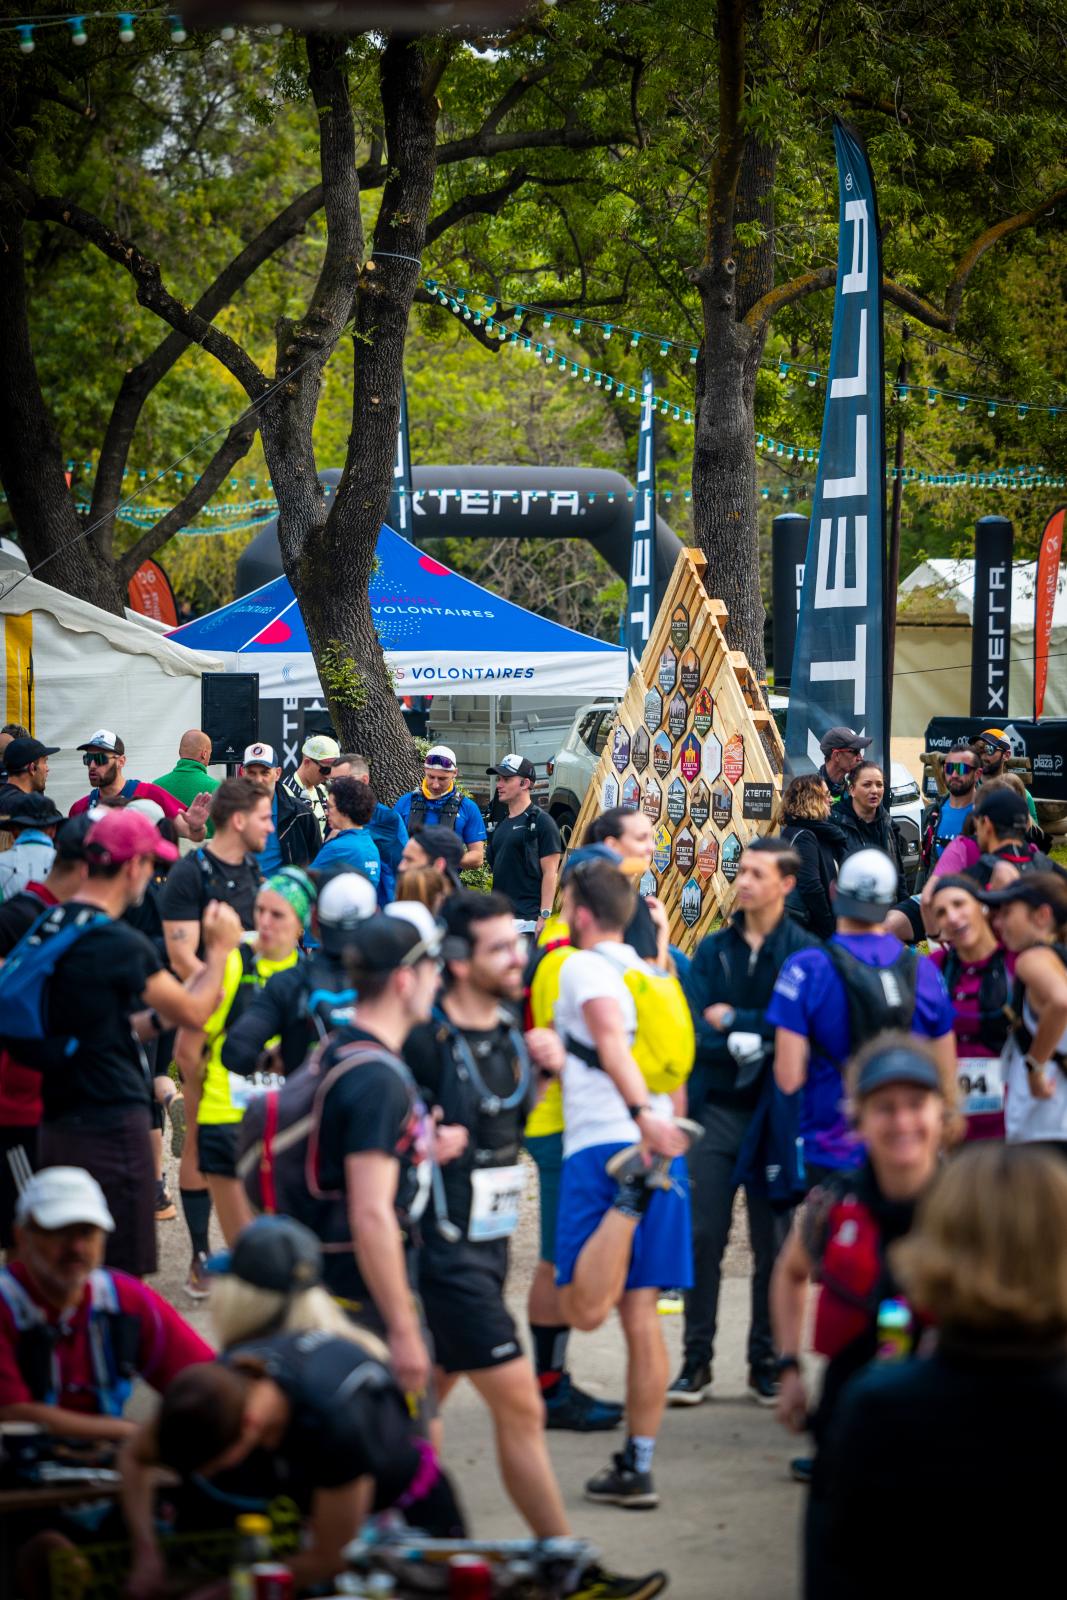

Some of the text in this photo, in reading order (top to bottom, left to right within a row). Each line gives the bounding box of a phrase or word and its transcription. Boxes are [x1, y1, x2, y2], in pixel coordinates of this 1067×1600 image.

[372, 606, 495, 618] VOLONTAIRES
[988, 565, 1006, 709] XTERRA
[411, 668, 535, 680] VOLONTAIRES
[1033, 754, 1054, 770] plaza
[745, 790, 772, 798] XTERRA
